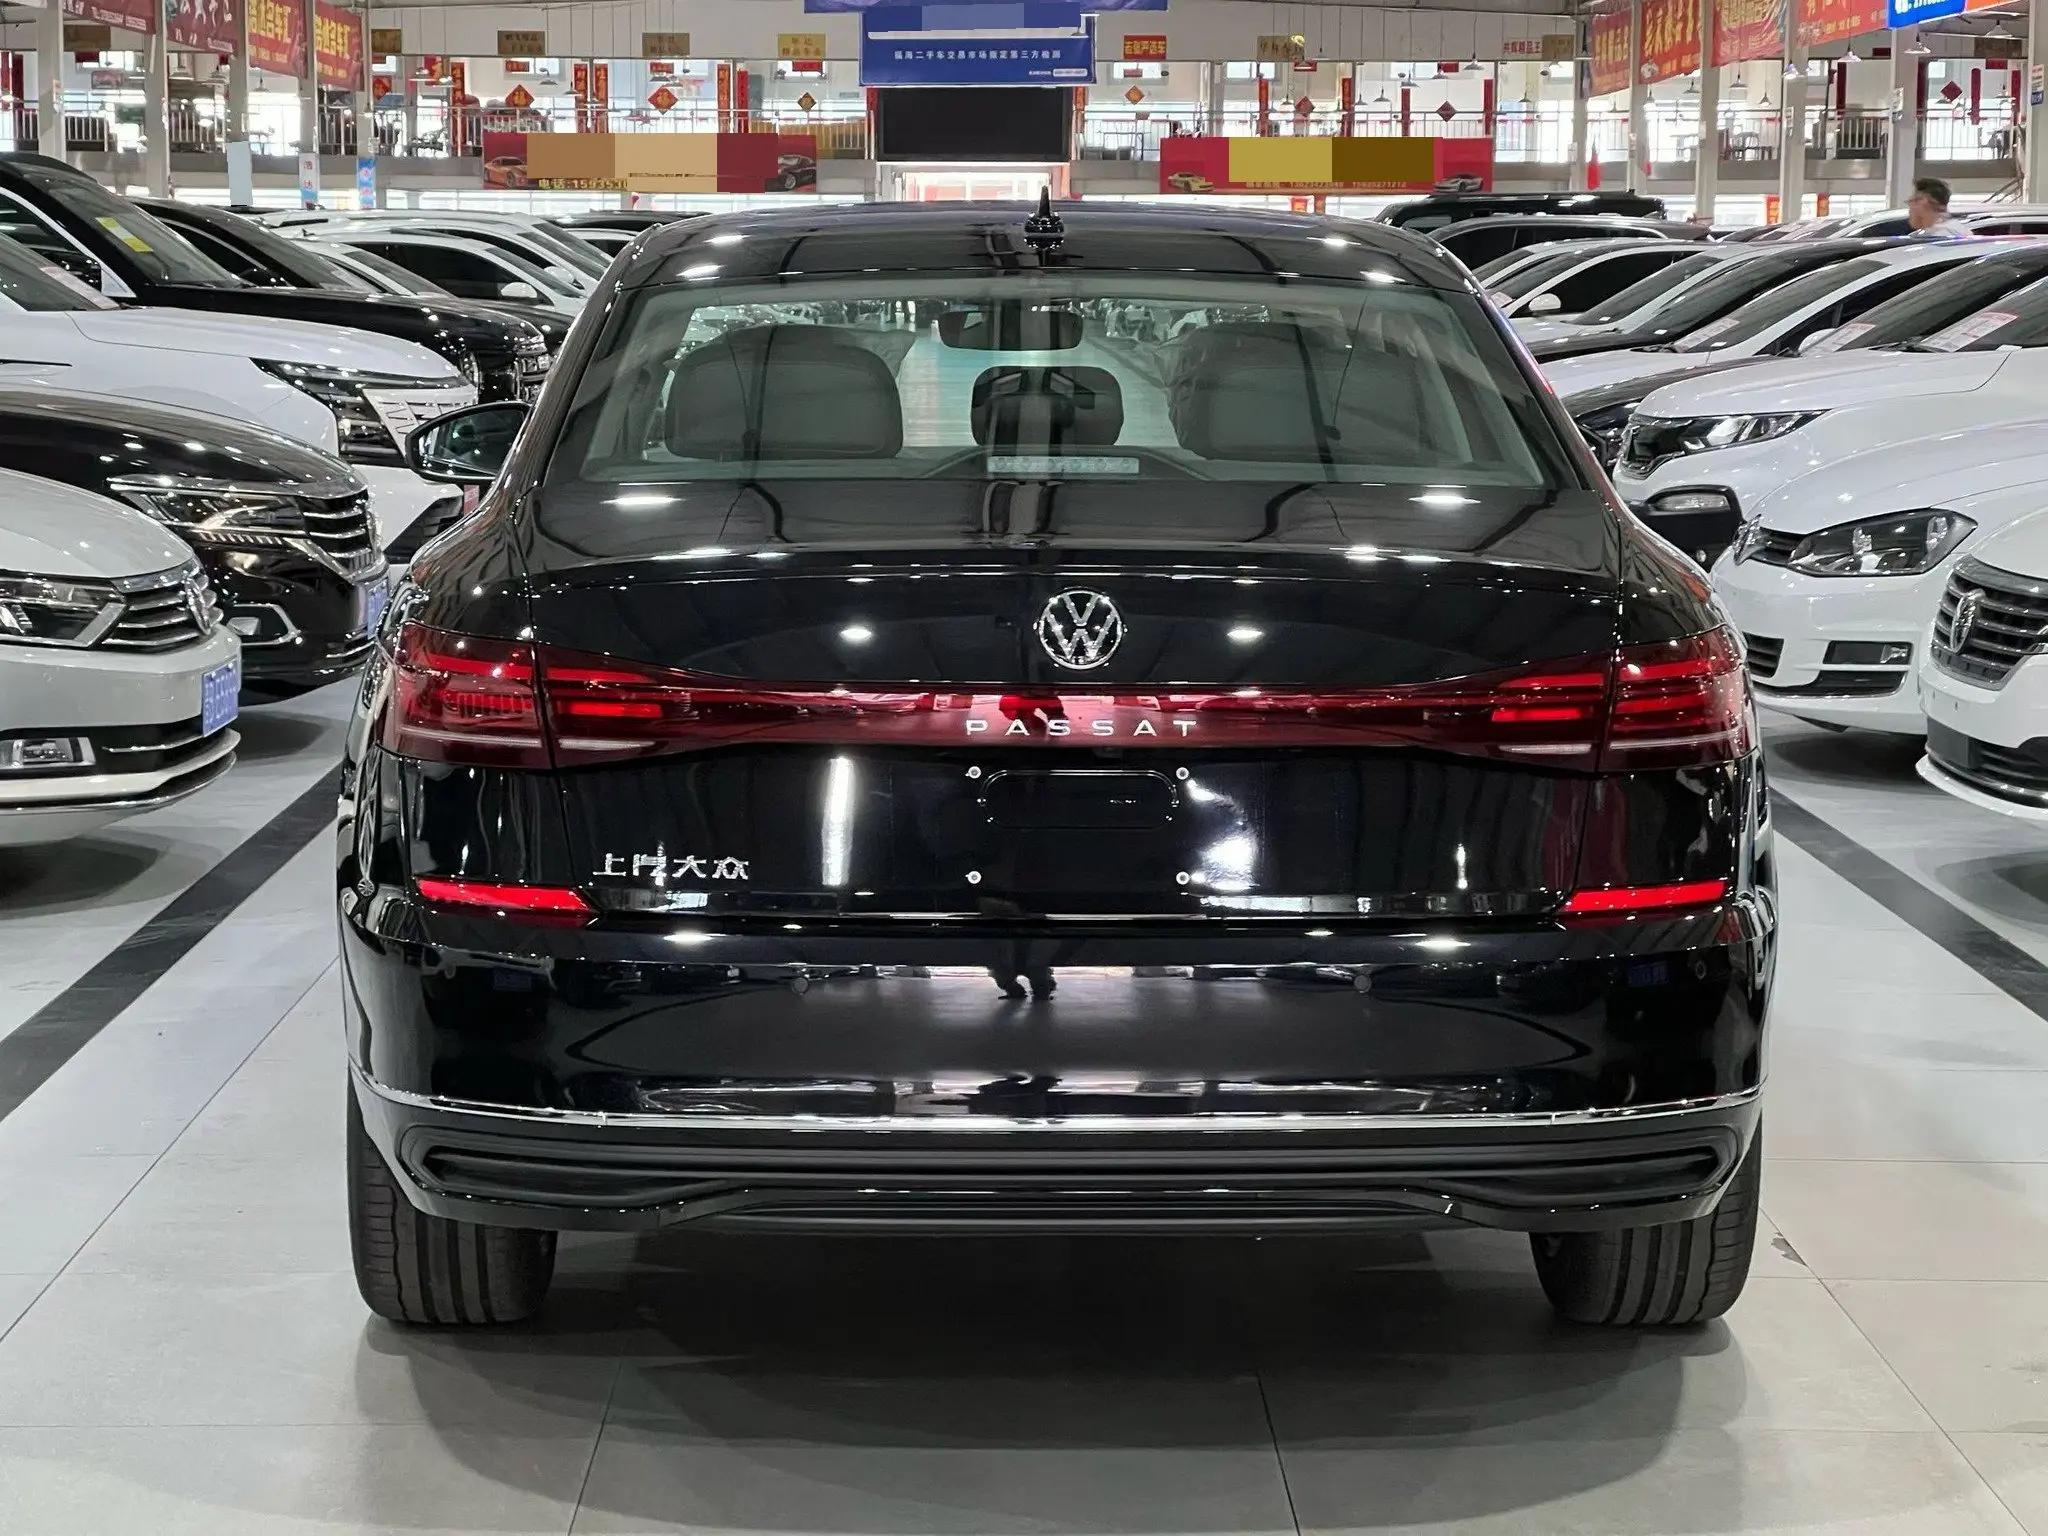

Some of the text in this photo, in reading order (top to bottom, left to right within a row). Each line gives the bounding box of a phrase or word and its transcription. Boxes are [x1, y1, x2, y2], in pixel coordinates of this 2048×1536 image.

[966, 719, 1197, 736] PASSAT
[592, 852, 749, 881] 上汽大众
